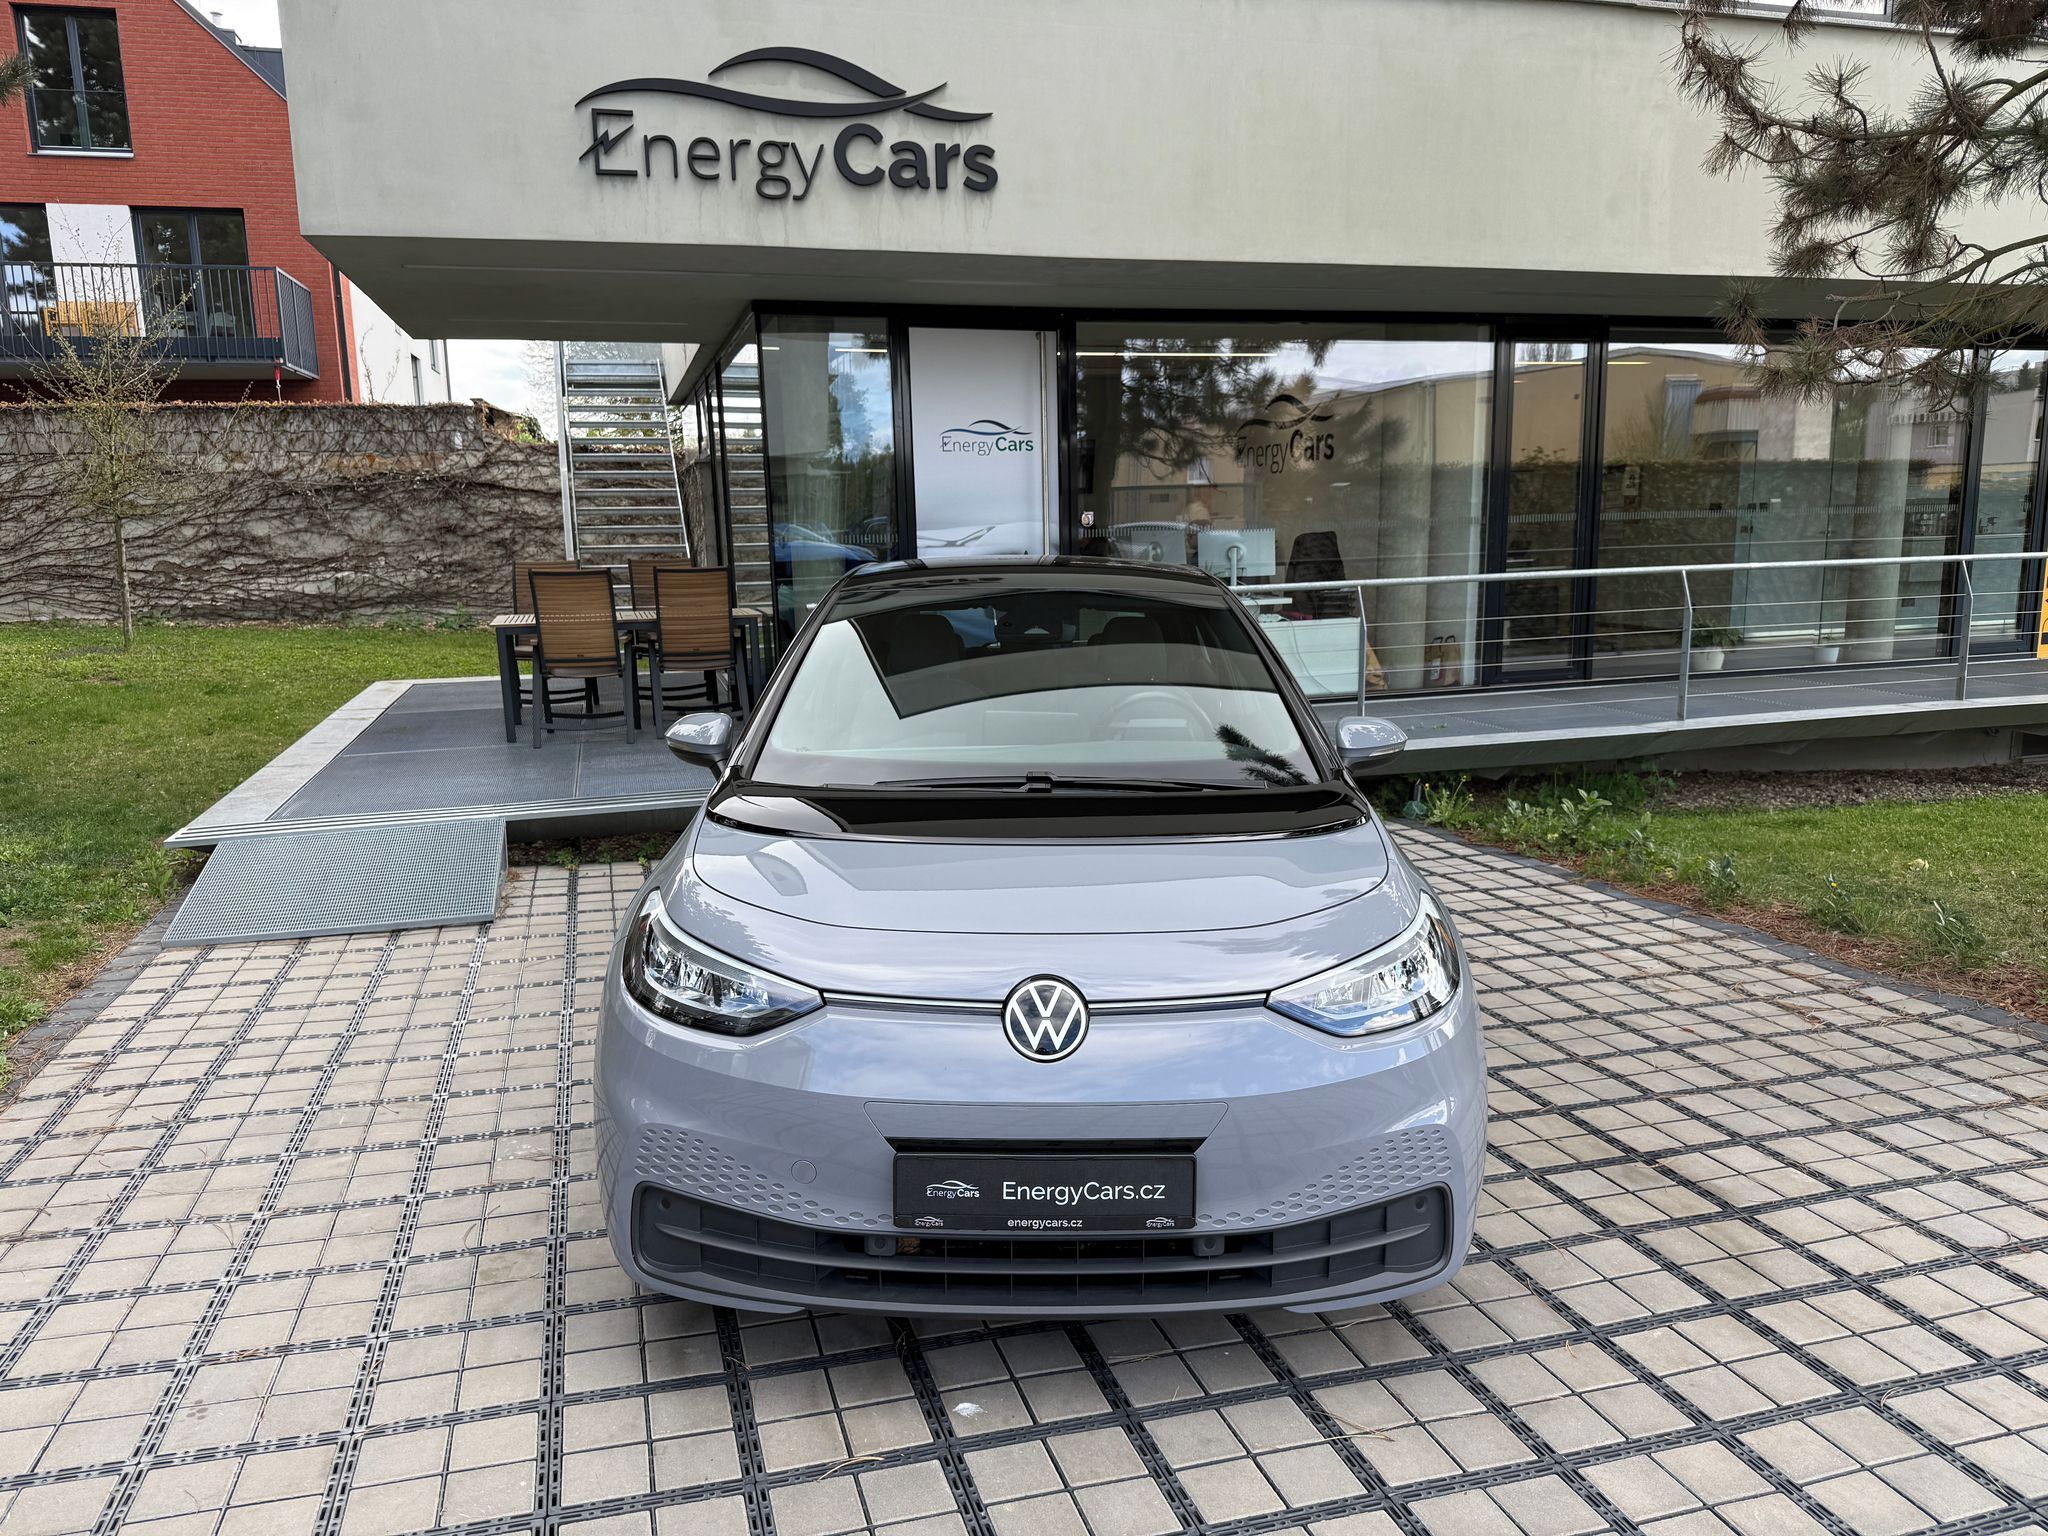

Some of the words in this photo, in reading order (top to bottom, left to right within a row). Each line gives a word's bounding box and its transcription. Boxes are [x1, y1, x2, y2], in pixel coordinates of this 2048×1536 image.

[579, 108, 998, 201] EnergyCars
[940, 435, 1034, 456] EnergyCars
[1235, 429, 1334, 474] EnergyCars
[926, 1188, 980, 1199] EnergyCars
[1002, 1181, 1166, 1206] EnergyCars.cz
[1007, 1219, 1083, 1229] energycars.cz
